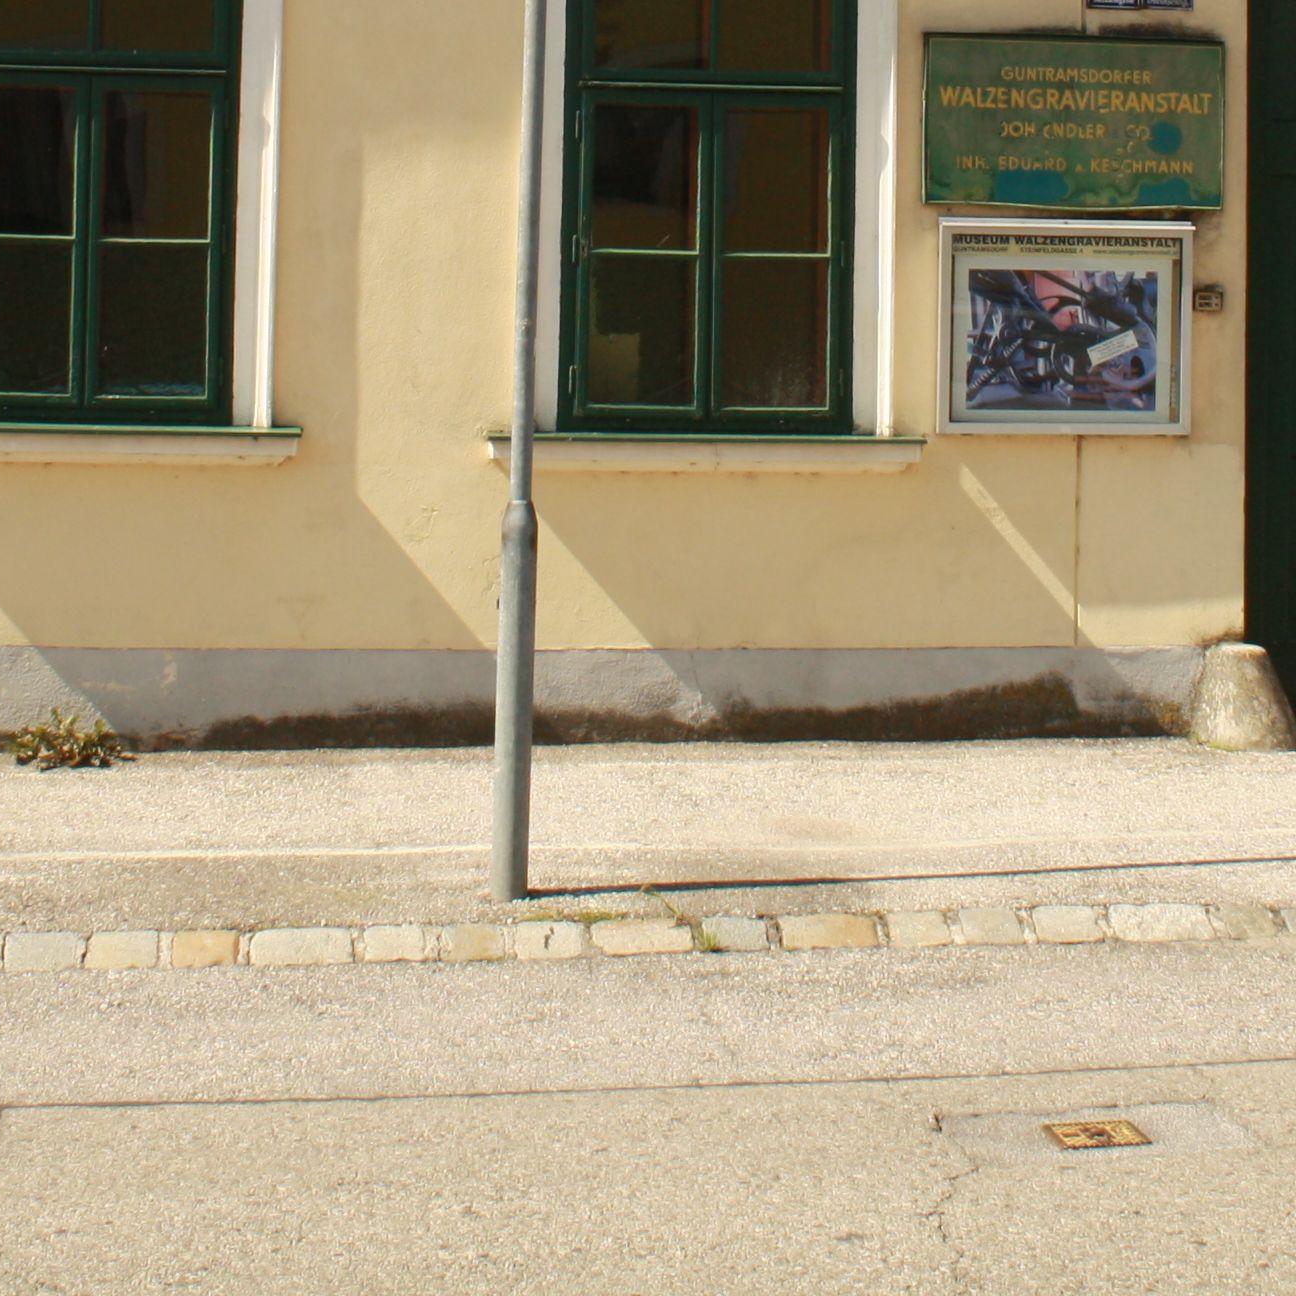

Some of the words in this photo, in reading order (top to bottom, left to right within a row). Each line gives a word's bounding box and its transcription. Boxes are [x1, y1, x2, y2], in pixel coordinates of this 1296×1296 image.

[1001, 66, 1152, 85] GUNTRAMSDORFER
[938, 86, 1213, 115] WALZENGRAVIERANSTALT
[954, 235, 1010, 245] MUSEUM
[1014, 235, 1177, 248] WALZENGRAVIERANSTALT
